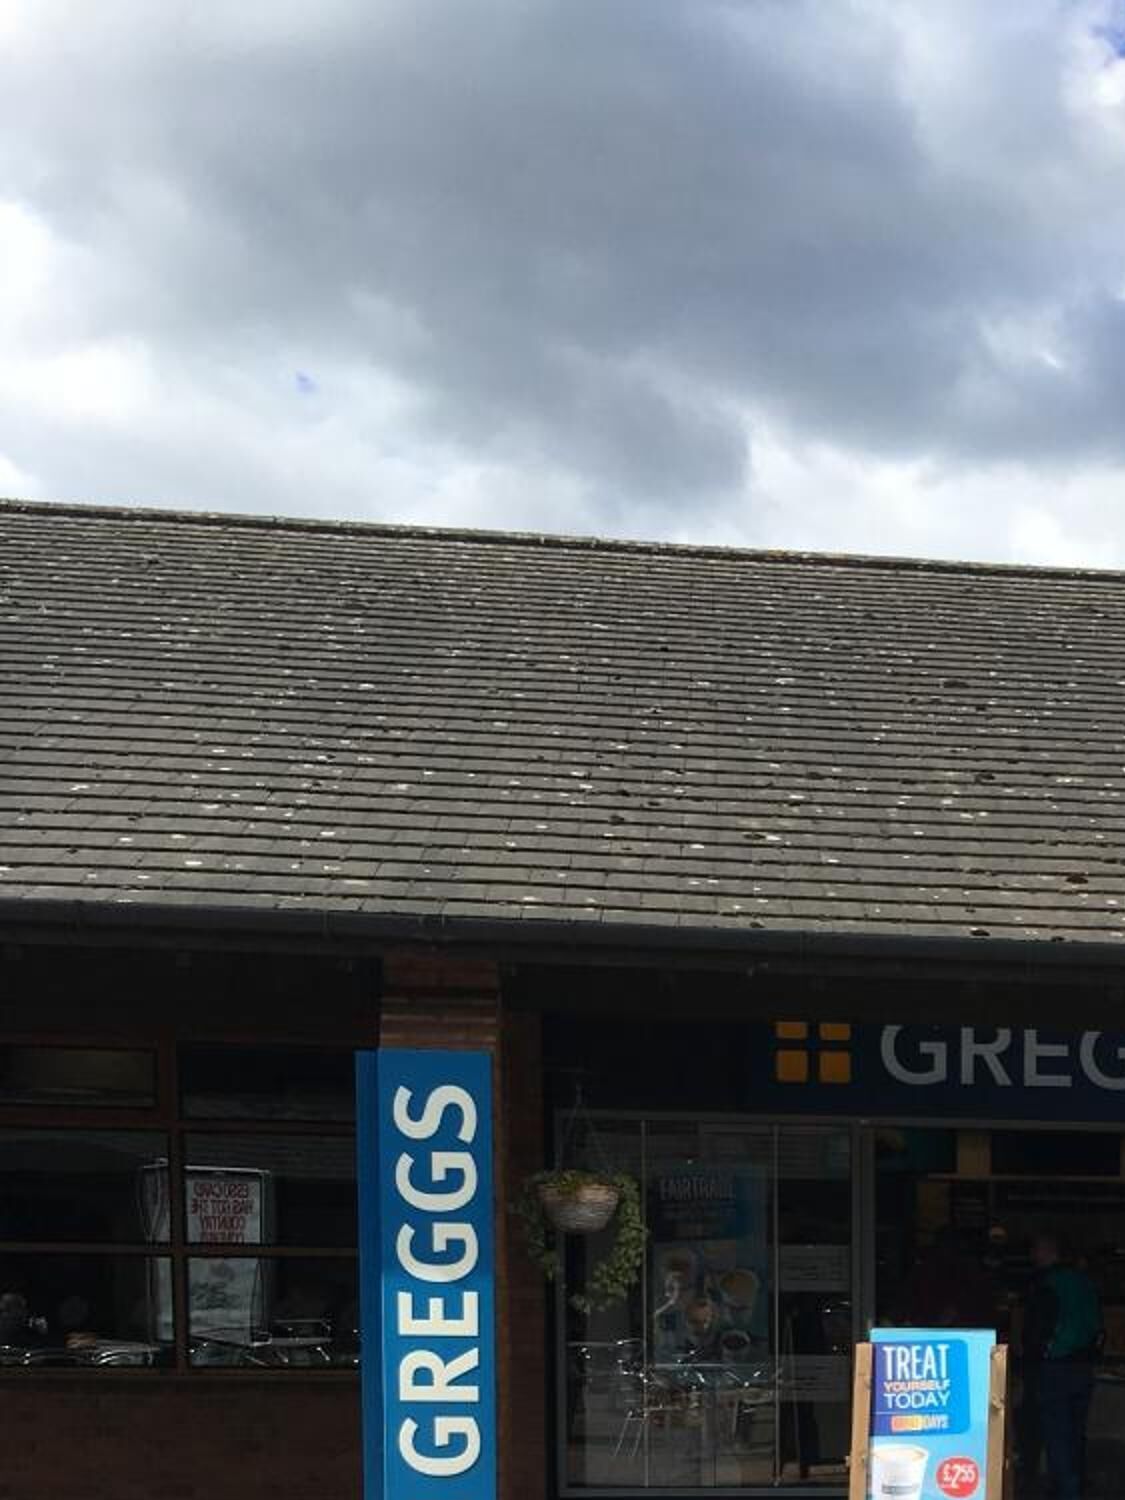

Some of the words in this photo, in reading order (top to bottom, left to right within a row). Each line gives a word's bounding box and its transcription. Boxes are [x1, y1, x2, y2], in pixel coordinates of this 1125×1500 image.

[393, 1084, 481, 1477] GREGGS
[882, 1344, 950, 1380] TREAT
[883, 1379, 951, 1392] YOURSELF
[883, 1391, 951, 1409] TODAY
